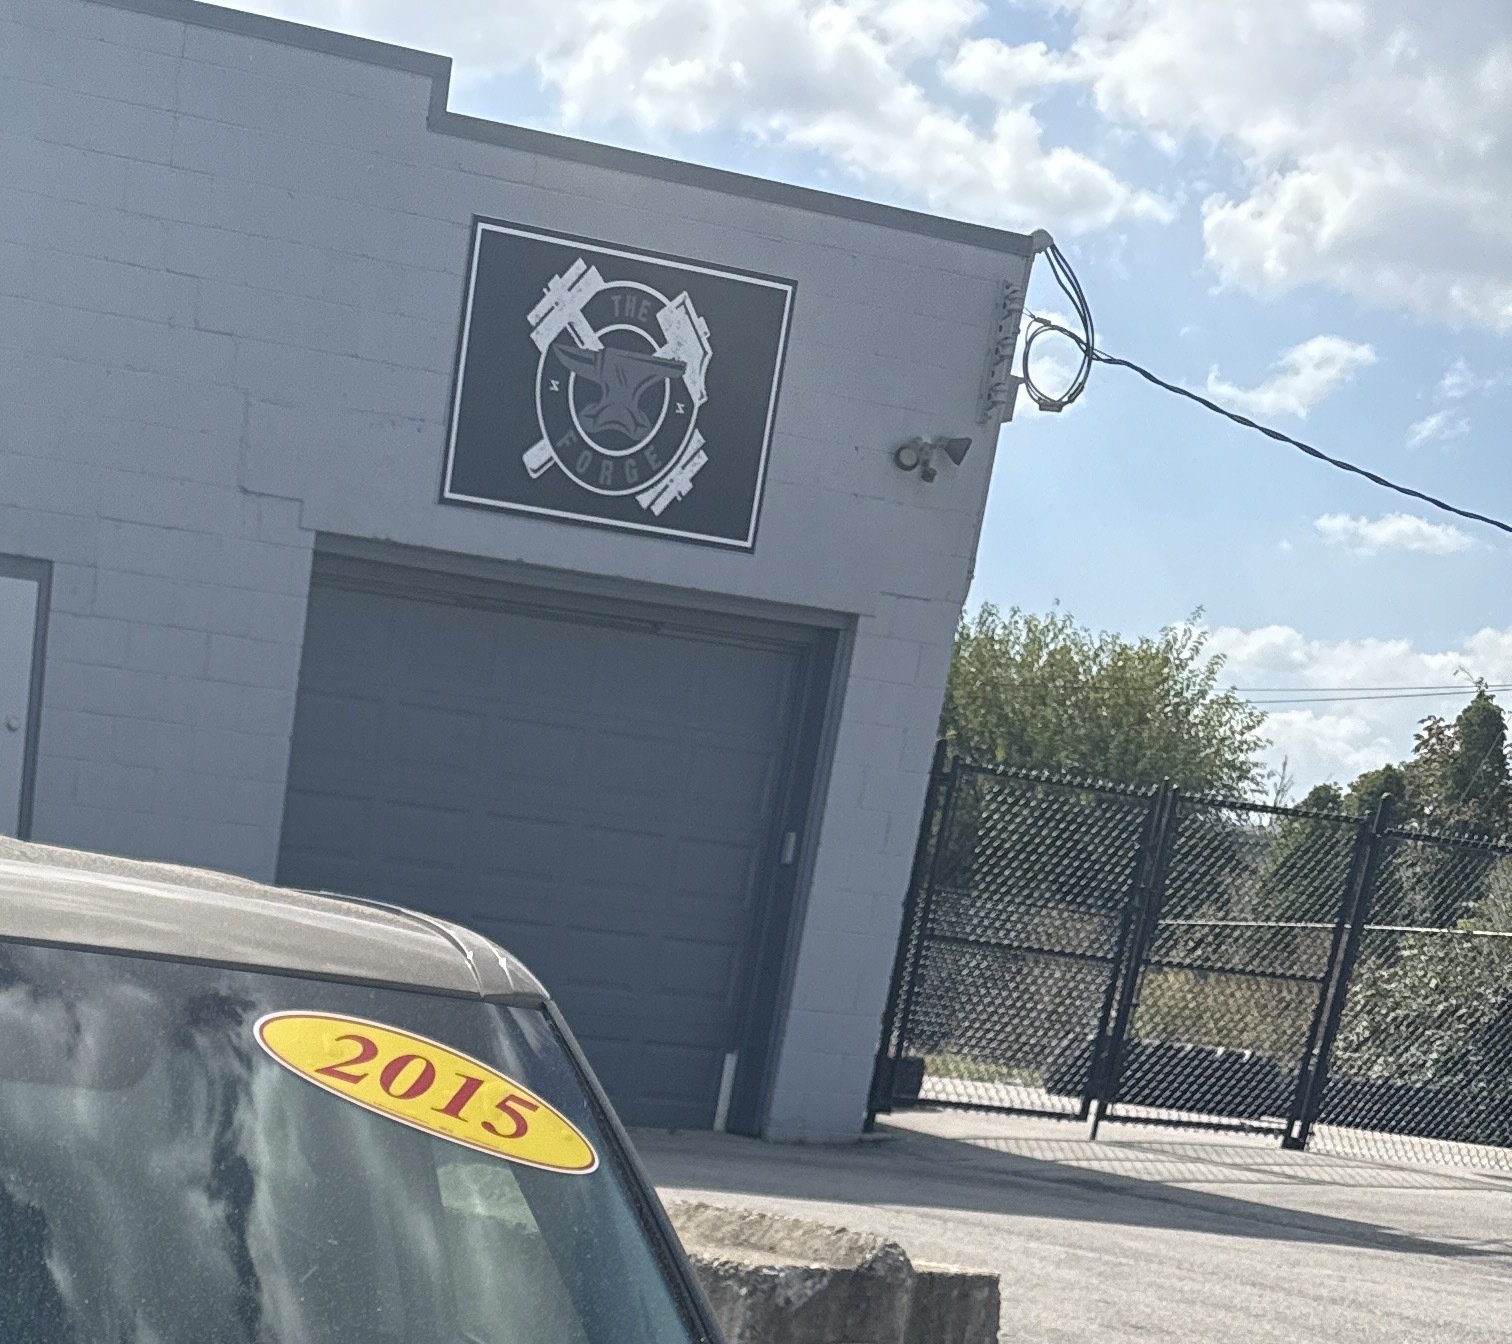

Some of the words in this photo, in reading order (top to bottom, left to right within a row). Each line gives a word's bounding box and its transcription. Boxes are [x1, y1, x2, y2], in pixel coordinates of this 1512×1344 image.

[611, 295, 652, 323] THE
[557, 430, 662, 486] FORGE
[315, 1034, 541, 1140] 2015
